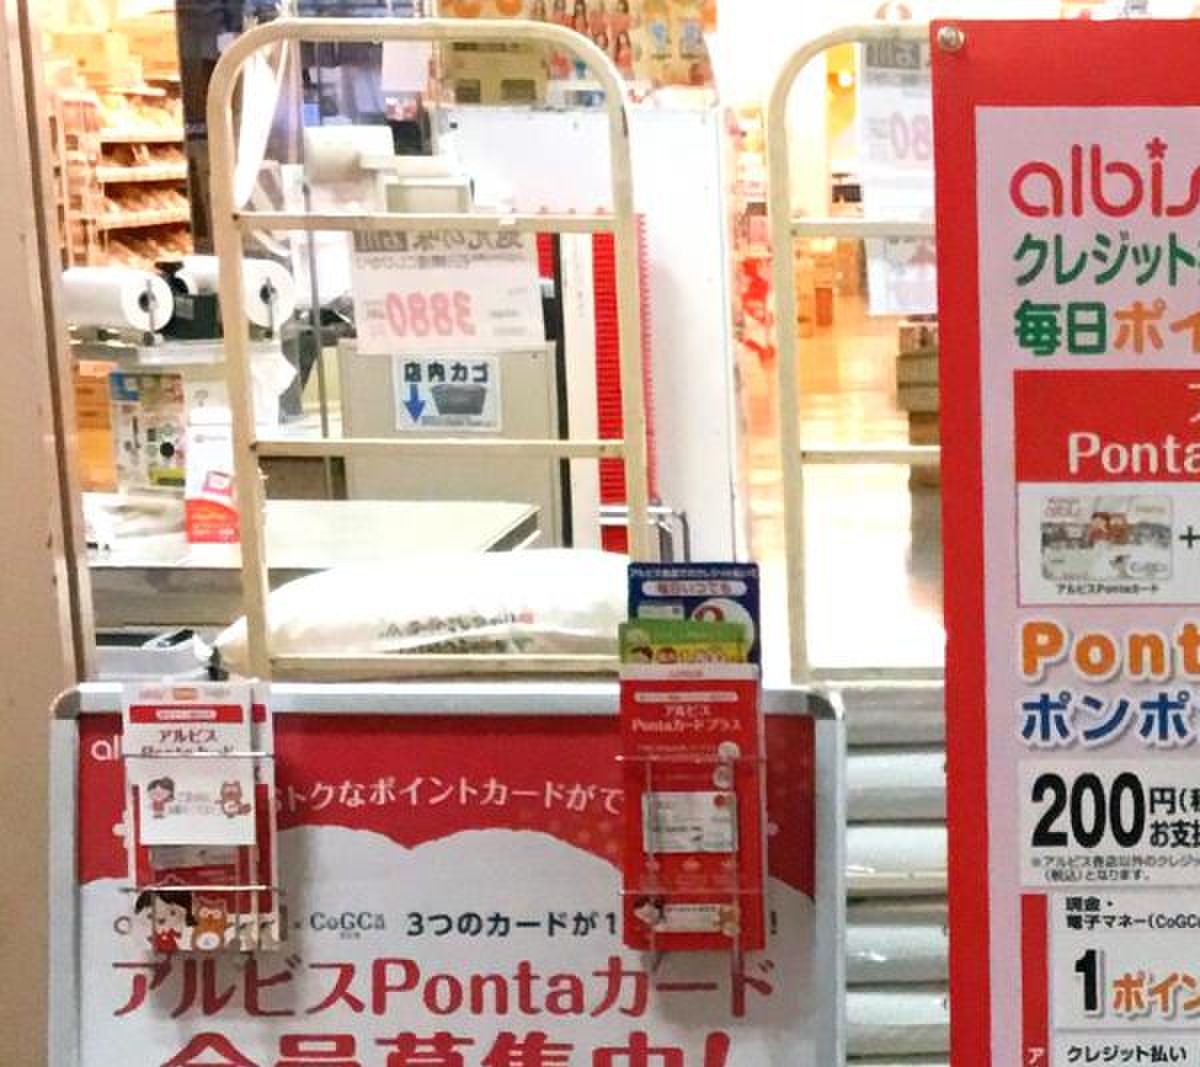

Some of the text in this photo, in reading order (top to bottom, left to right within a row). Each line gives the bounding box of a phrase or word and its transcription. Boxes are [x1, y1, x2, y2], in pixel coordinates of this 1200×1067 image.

[404, 362, 489, 383] 店内カゴ
[159, 729, 217, 743] アルビス
[112, 954, 776, 1019] アルビスPontaカード
[1067, 1045, 1188, 1063] クレジット払い
